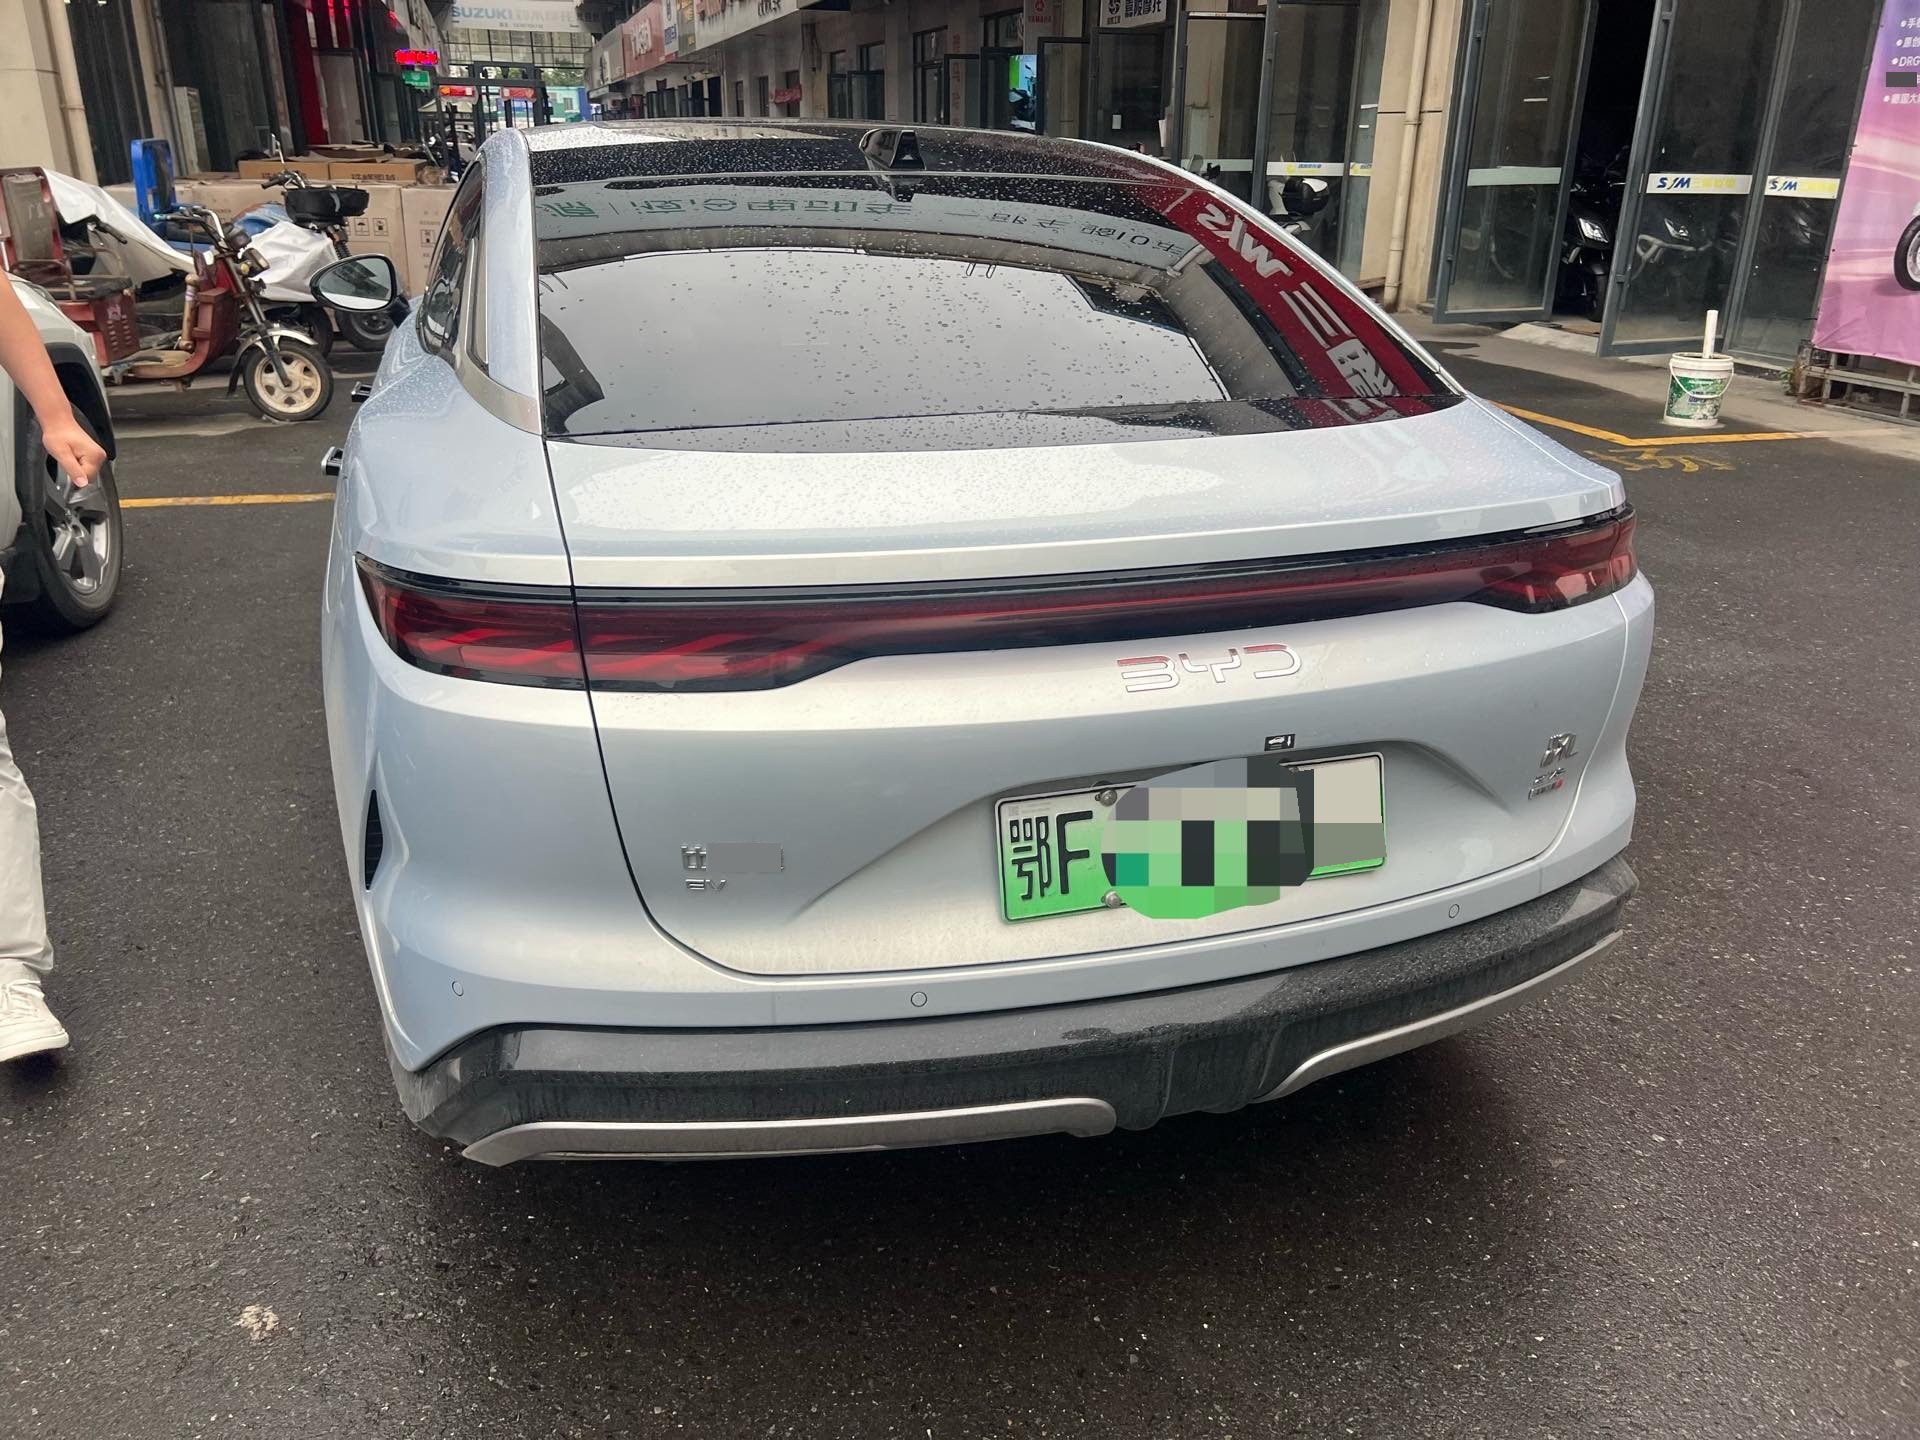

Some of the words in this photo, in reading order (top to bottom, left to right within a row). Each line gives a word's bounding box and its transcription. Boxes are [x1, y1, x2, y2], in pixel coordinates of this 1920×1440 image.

[452, 6, 512, 20] SUZUKI
[1117, 643, 1302, 692] BYD
[685, 878, 727, 891] EV
